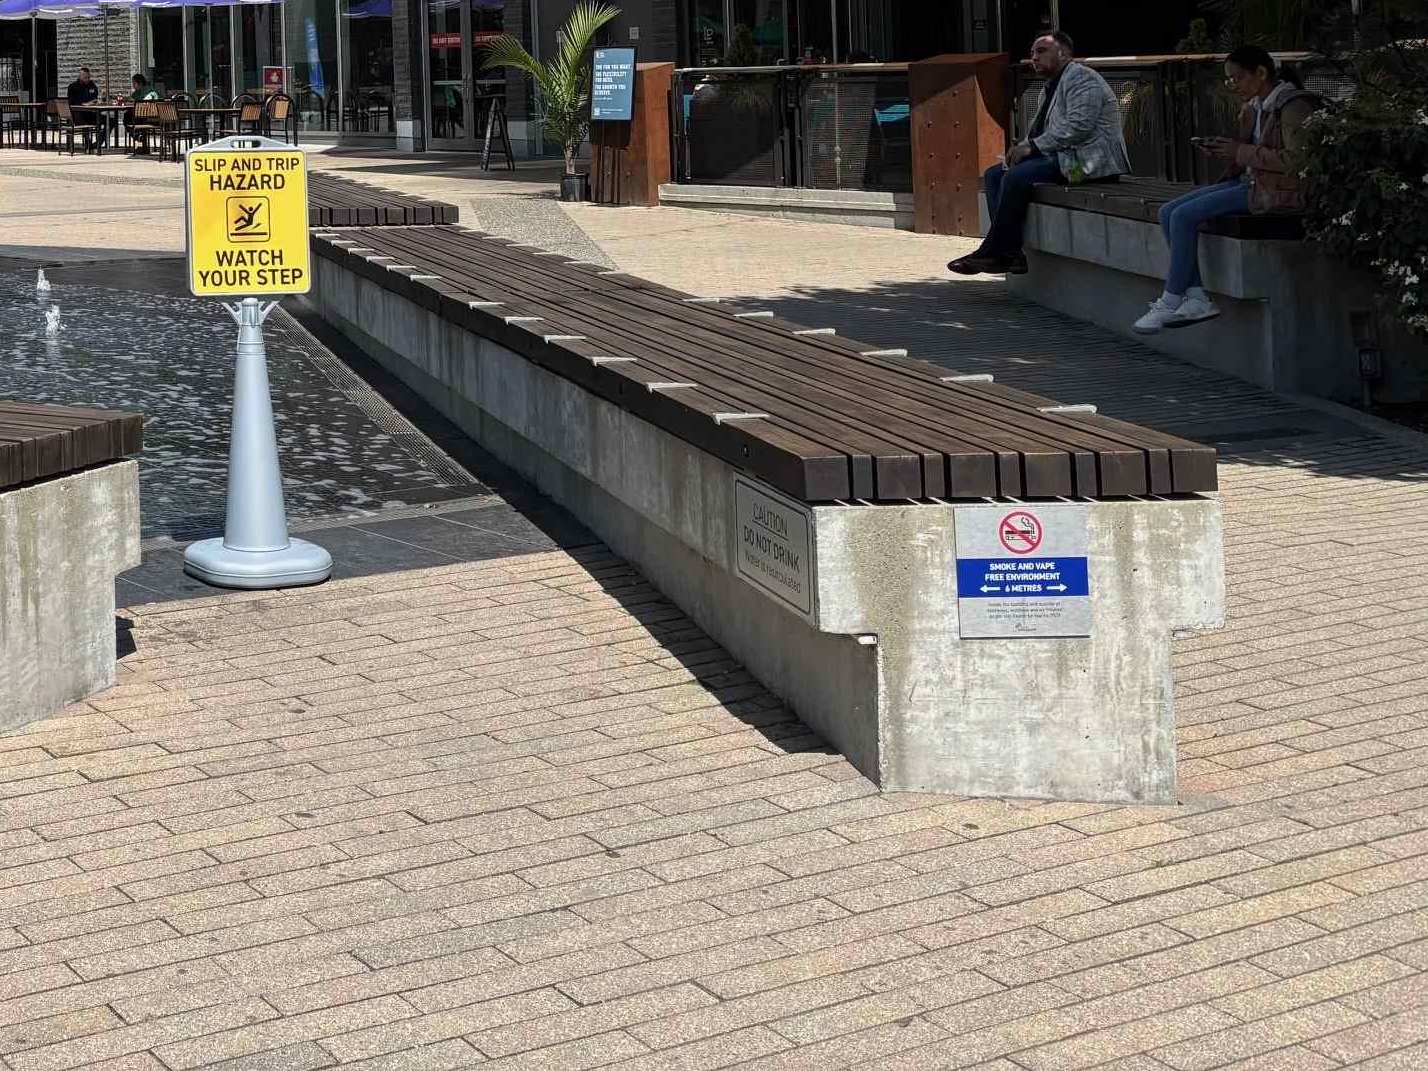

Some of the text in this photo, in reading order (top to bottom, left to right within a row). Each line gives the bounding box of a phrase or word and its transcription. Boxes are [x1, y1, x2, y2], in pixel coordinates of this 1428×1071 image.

[194, 157, 300, 172] SLIP AND TRIP
[210, 174, 285, 191] HAZARD
[215, 249, 284, 267] WATCH
[198, 268, 304, 287] YOUR STEP
[753, 503, 788, 537] CAUTION
[743, 525, 800, 574] DO NOT DRINK
[990, 562, 1055, 571] SMOKE AND VAPE
[985, 572, 1060, 581] FREE ENVIRONMENT
[1005, 584, 1042, 593] 6 METRES
